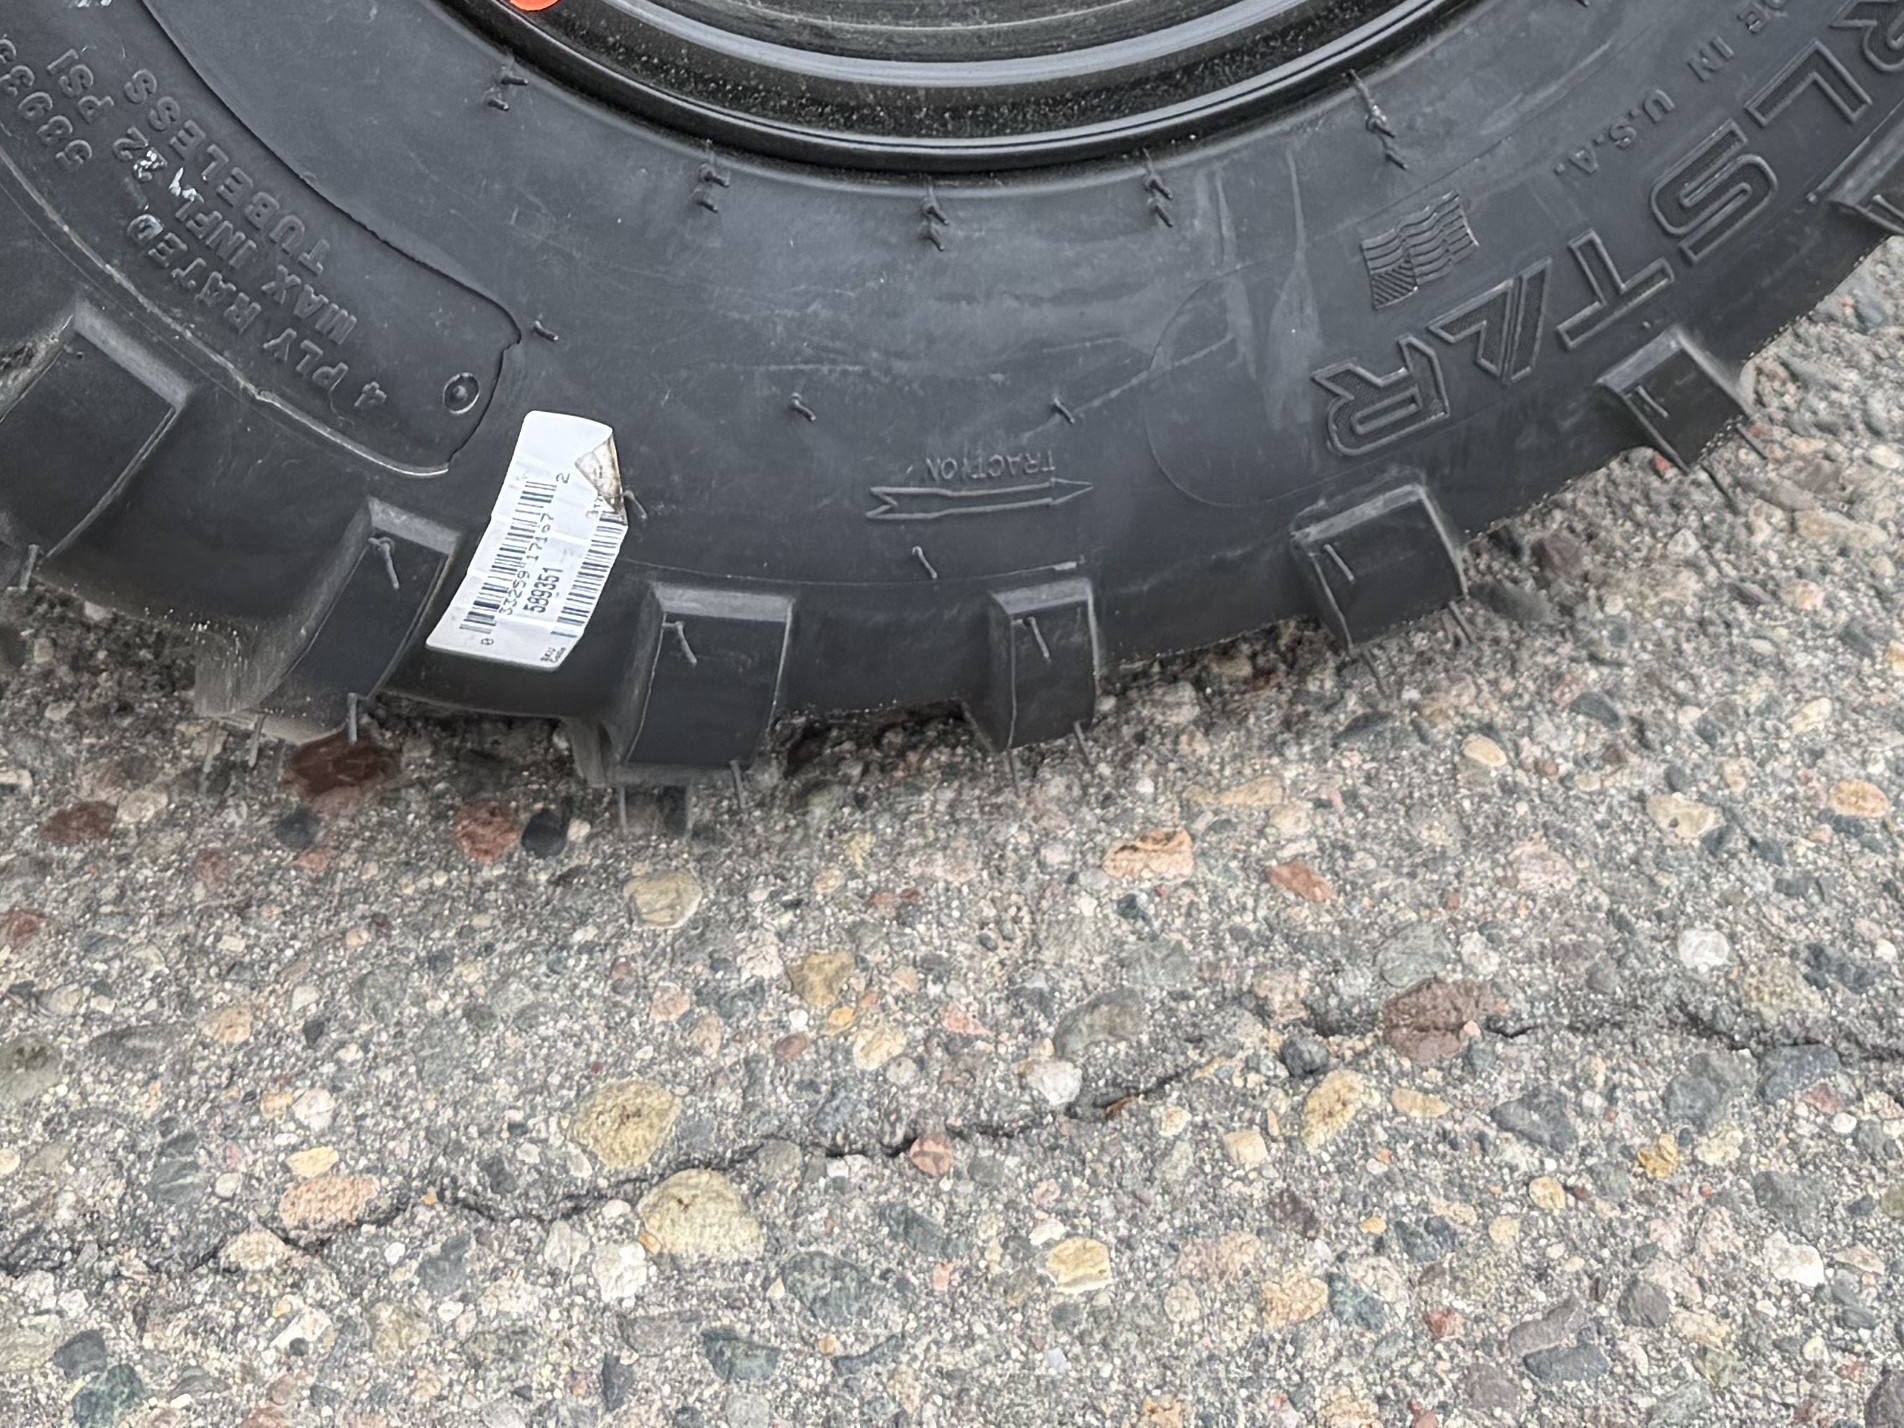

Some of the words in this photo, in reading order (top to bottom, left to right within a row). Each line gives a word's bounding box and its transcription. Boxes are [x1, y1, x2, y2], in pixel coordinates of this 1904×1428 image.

[45, 47, 116, 124] PSI
[1686, 34, 1736, 83] IN
[112, 124, 170, 183] 22
[122, 68, 332, 277] TUBELESS
[126, 212, 263, 335] RATED
[261, 263, 358, 346] MAX
[262, 326, 350, 393] PLY
[353, 380, 389, 410] 4
[924, 446, 1058, 485] TRACTION
[498, 570, 531, 616] 33259
[555, 471, 571, 485] 2
[522, 566, 564, 614] 589351
